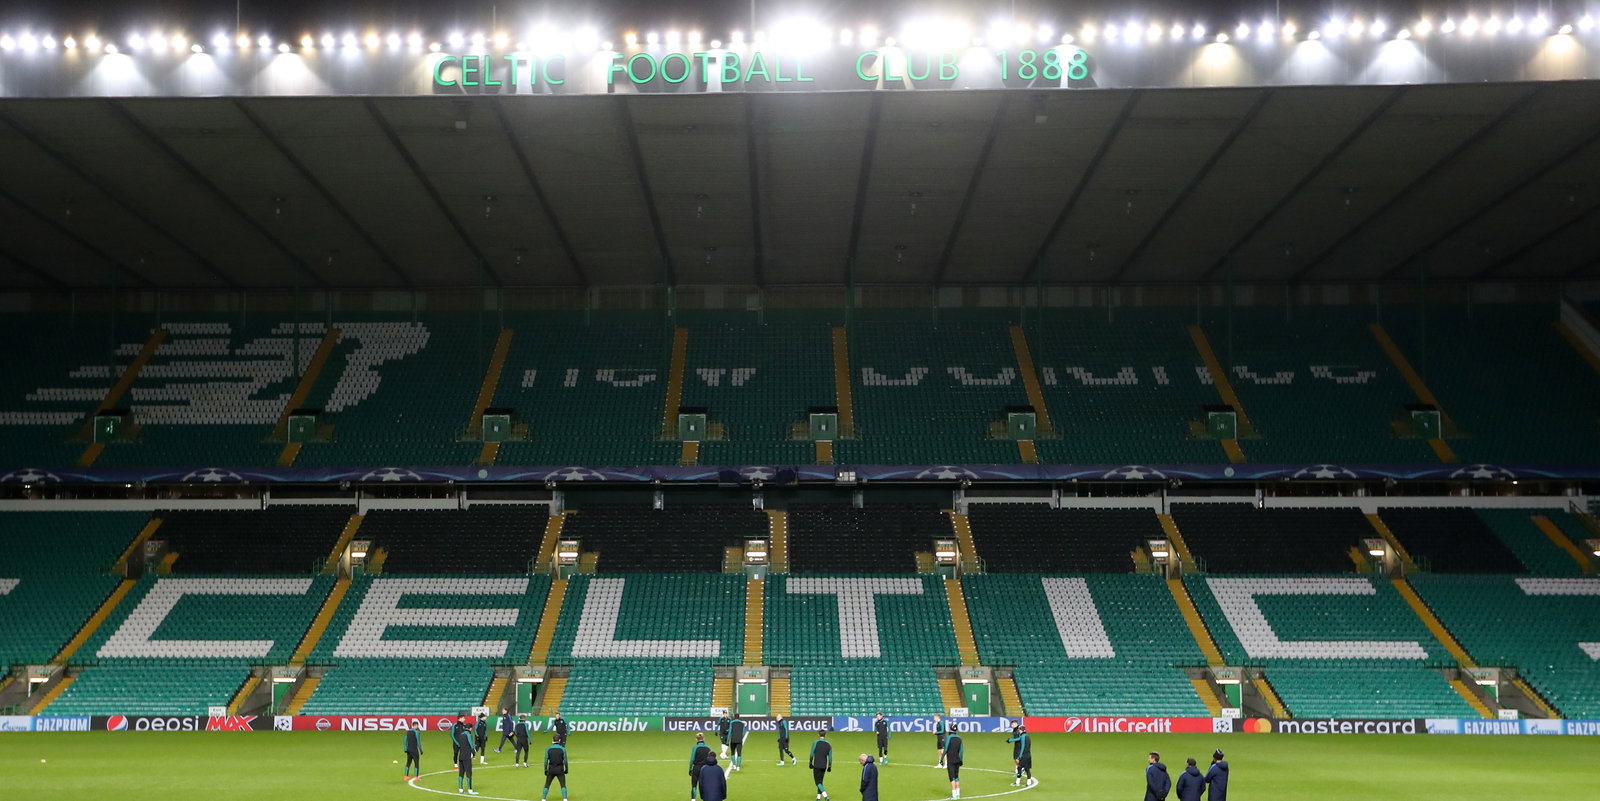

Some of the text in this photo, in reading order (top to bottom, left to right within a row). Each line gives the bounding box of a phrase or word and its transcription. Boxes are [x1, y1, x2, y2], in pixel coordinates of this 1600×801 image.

[433, 49, 1089, 86] CELTIC FOOTBALL CLUB 1888
[96, 577, 1429, 659] CELTIC
[36, 716, 89, 731] GAZPROM
[135, 715, 259, 731] pepsi MAX
[341, 718, 428, 731] NISSAN
[668, 720, 701, 731] UEFA
[787, 720, 829, 731] EAGUE
[1085, 718, 1172, 732] UniCredit
[1279, 718, 1416, 734] mastercard
[1464, 721, 1520, 734] GAZPROM
